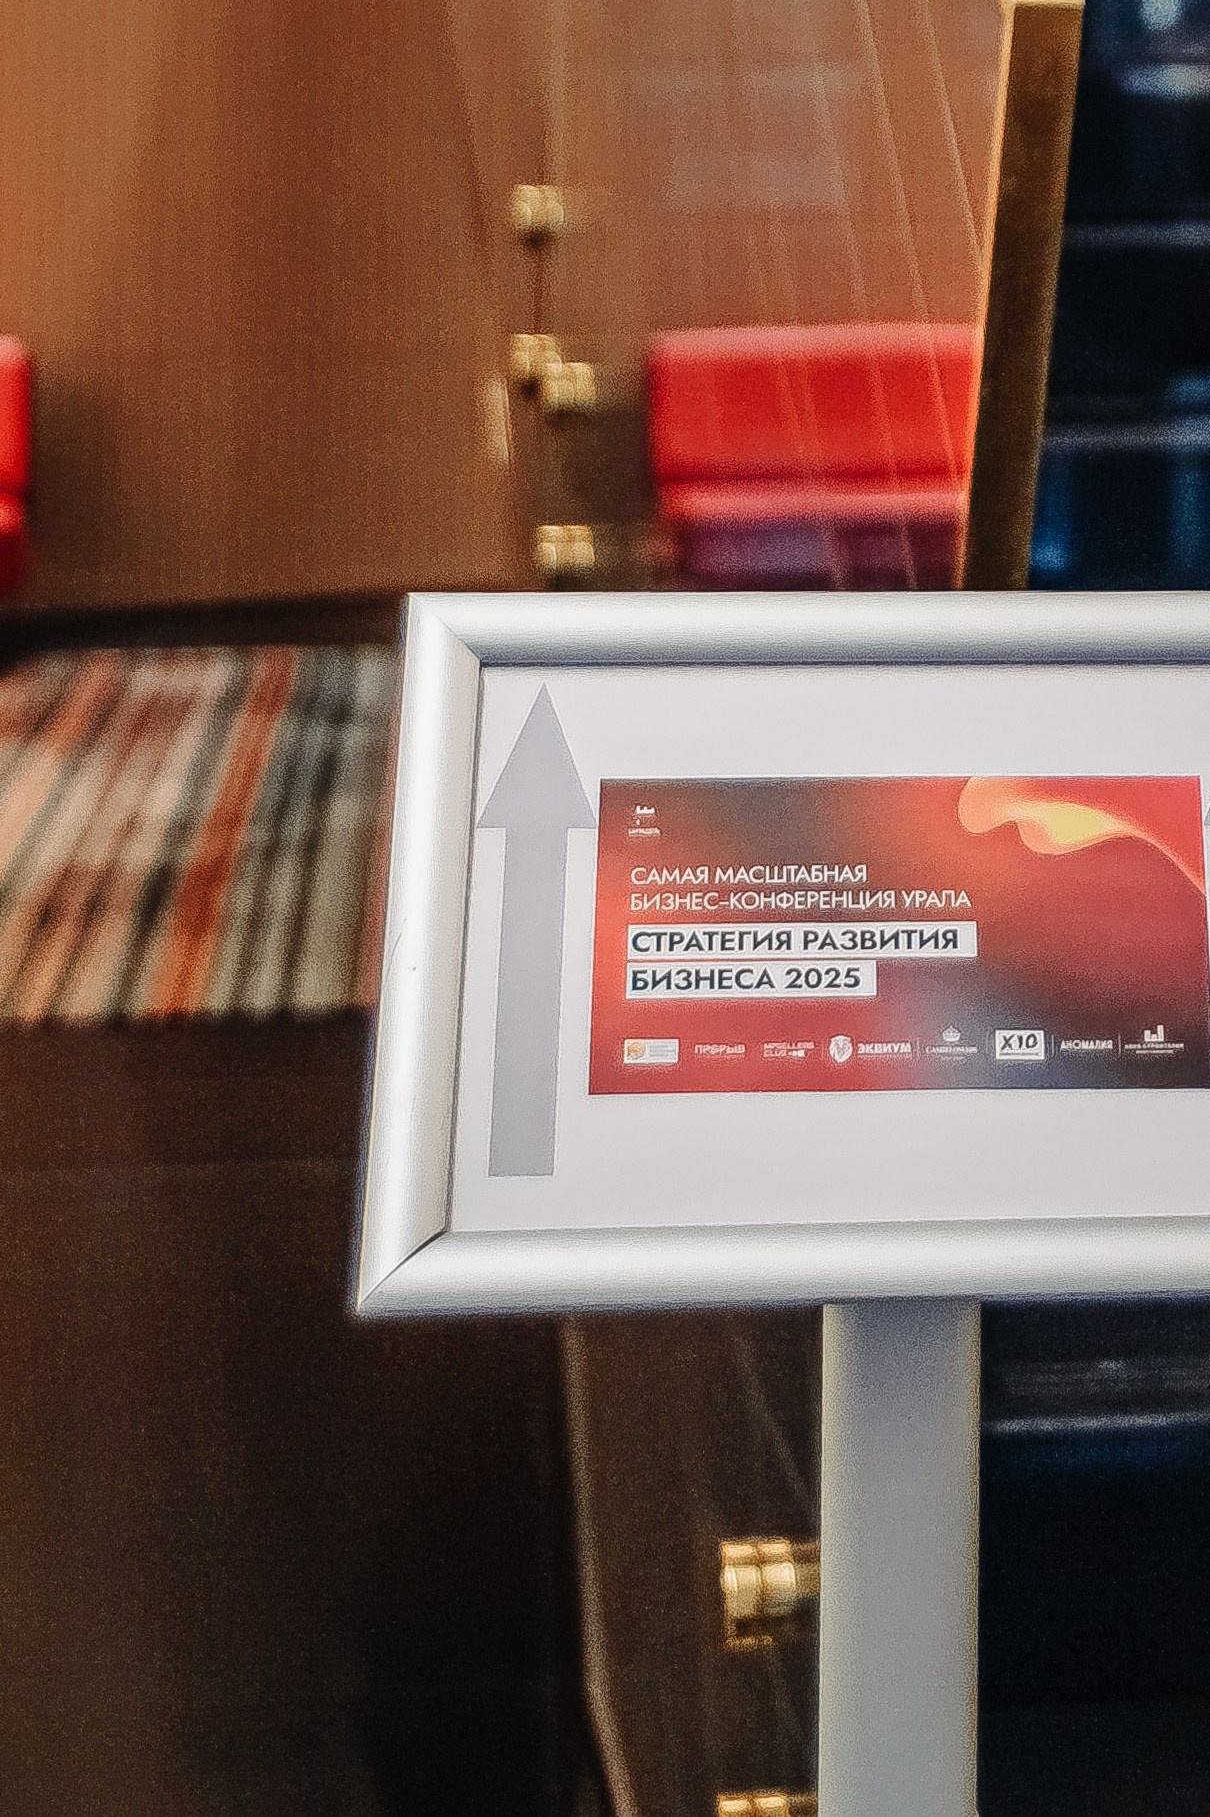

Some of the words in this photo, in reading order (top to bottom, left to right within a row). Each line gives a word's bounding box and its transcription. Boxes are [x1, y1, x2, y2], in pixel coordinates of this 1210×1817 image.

[630, 865, 710, 885] САМАЯ
[714, 864, 868, 884] МАСШТАБНАЯ
[630, 889, 896, 911] БИЗНЕС-КОНФЕРЕНЦИЯ
[901, 889, 972, 909] УРАЛА
[631, 929, 793, 953] СТРАТЕГИЯ
[802, 928, 959, 951] РАЗВИТИЯ
[631, 967, 776, 991] БИЗНЕСА
[784, 966, 862, 990] 2025
[857, 1042, 913, 1054] ЭКВИУМ
[1060, 1039, 1114, 1050] АНОМАЛИЯ
